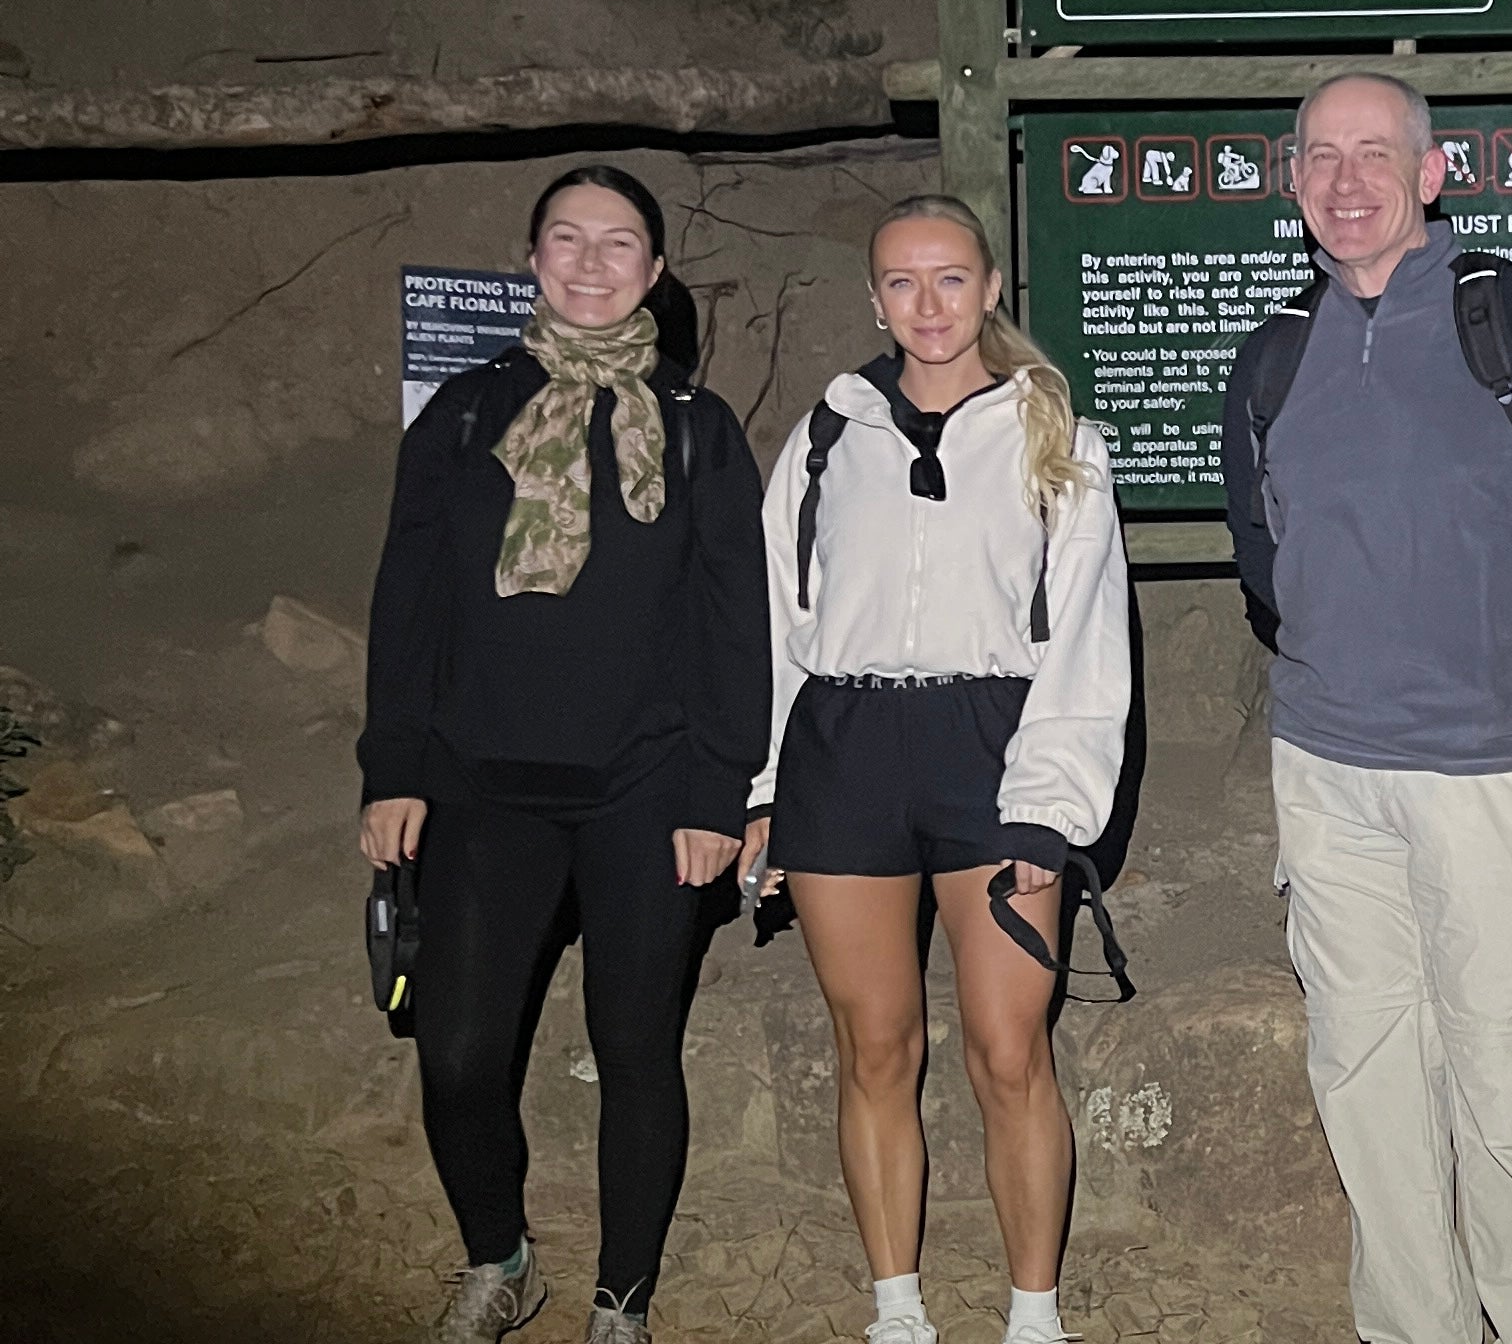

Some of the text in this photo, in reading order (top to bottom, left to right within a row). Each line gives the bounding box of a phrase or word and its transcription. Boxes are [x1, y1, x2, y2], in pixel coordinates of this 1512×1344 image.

[1082, 254, 1101, 270] By
[1107, 254, 1165, 269] entering
[1172, 253, 1198, 265] this
[1204, 254, 1235, 265] area
[1241, 251, 1286, 264] and/or
[1082, 271, 1109, 284] this
[1119, 270, 1173, 285] activity,
[1183, 272, 1209, 285] you
[1219, 271, 1241, 281] are
[405, 275, 535, 298] PROTECTING THE
[1082, 287, 1140, 304] yourself
[1147, 288, 1162, 299] to
[1170, 286, 1204, 299] risks
[1212, 286, 1238, 298] and
[406, 293, 445, 308] CAPE
[450, 297, 506, 313] FLORAL
[1083, 305, 1134, 320] activity
[1144, 304, 1169, 316] like
[1178, 303, 1209, 316] this.
[1218, 302, 1254, 315] Such
[1084, 321, 1135, 334] include
[1139, 321, 1162, 333] but
[1166, 323, 1189, 333] are
[1193, 321, 1216, 332] not
[1092, 347, 1236, 362] You could be exposed
[1095, 366, 1153, 377] elements
[1163, 364, 1187, 376] and
[1197, 364, 1209, 375] to
[1095, 381, 1145, 393] criminal
[1150, 381, 1212, 393] elements,
[1095, 398, 1107, 409] to
[1111, 399, 1140, 412] your
[1101, 425, 1118, 436] ou
[1106, 441, 1120, 452] nd
[1110, 456, 1167, 468] asonable
